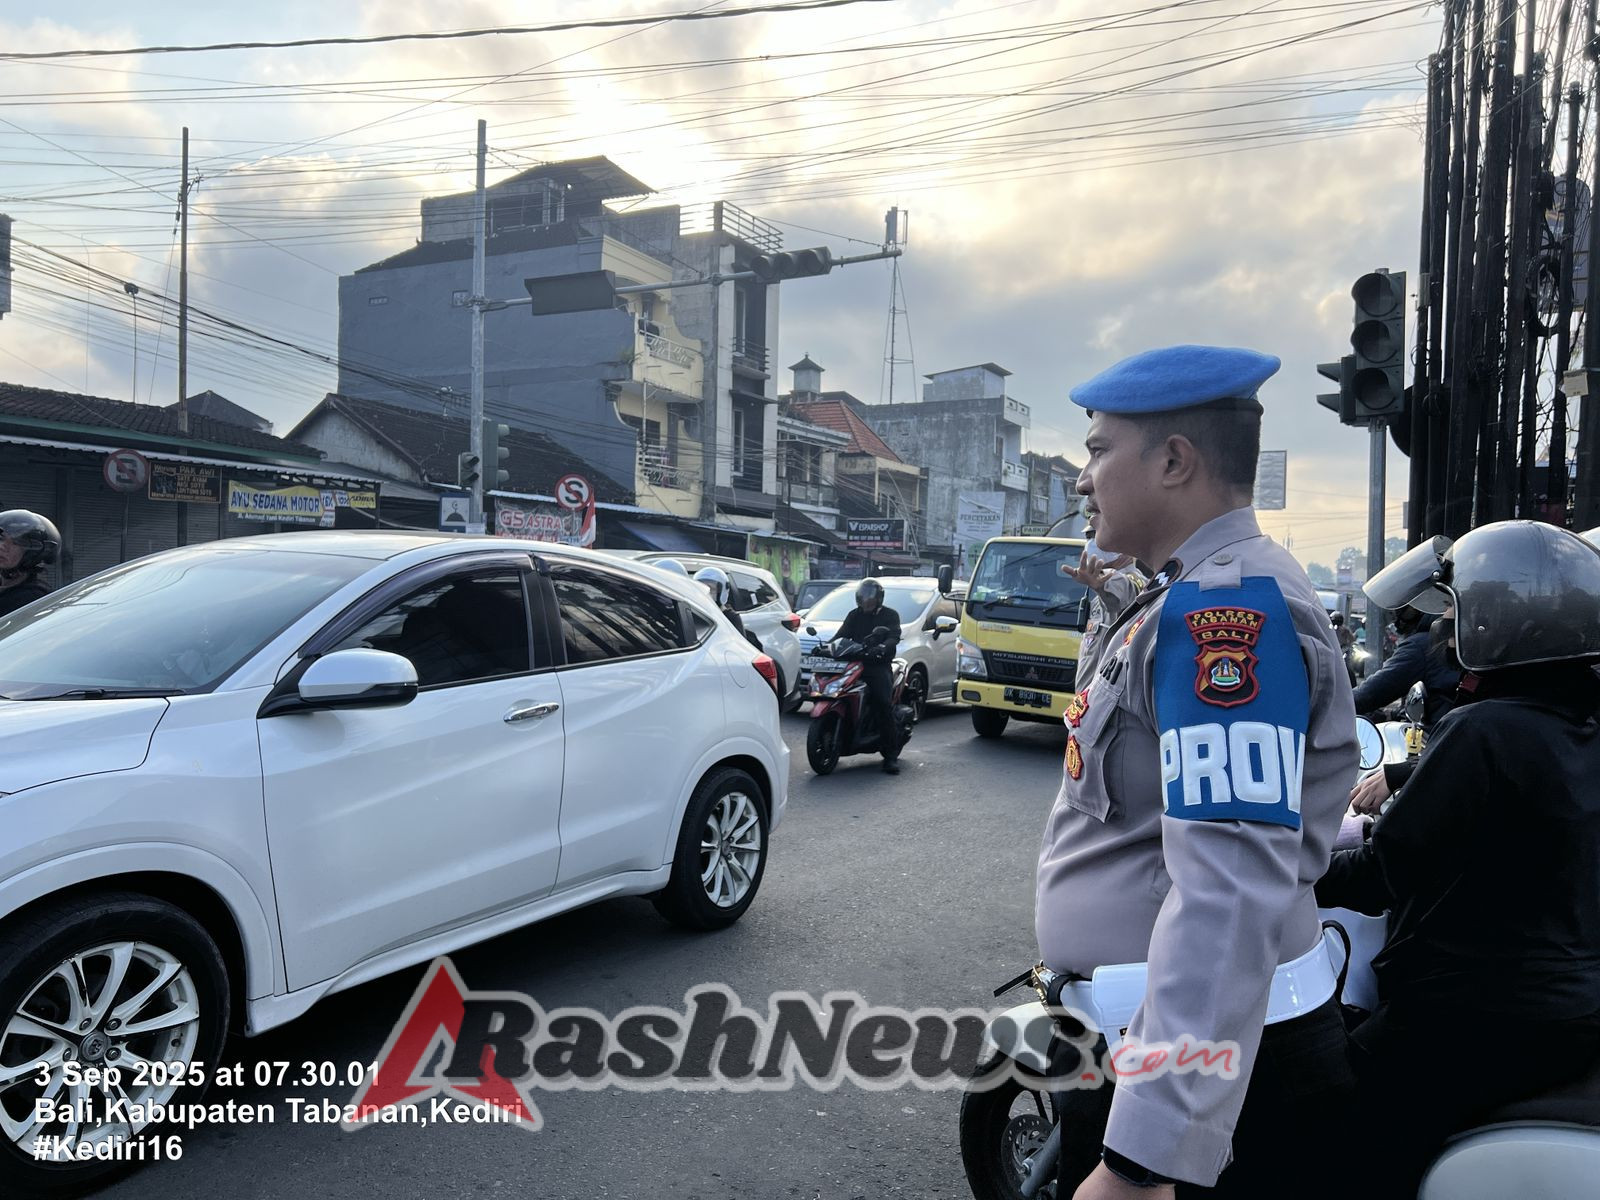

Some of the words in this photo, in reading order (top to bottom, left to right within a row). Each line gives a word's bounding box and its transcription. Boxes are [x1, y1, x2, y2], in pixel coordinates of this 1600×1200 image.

[231, 491, 250, 508] AYU
[252, 494, 288, 510] SEDANA
[290, 496, 320, 513] MOTOR
[500, 509, 525, 528] GS
[526, 513, 561, 529] ASTRA
[1192, 614, 1258, 628] TABANAN
[1193, 609, 1255, 621] POLRES
[1201, 630, 1250, 640] BALI
[992, 652, 1046, 662] MITSUBISHI
[1047, 658, 1075, 666] FUSO
